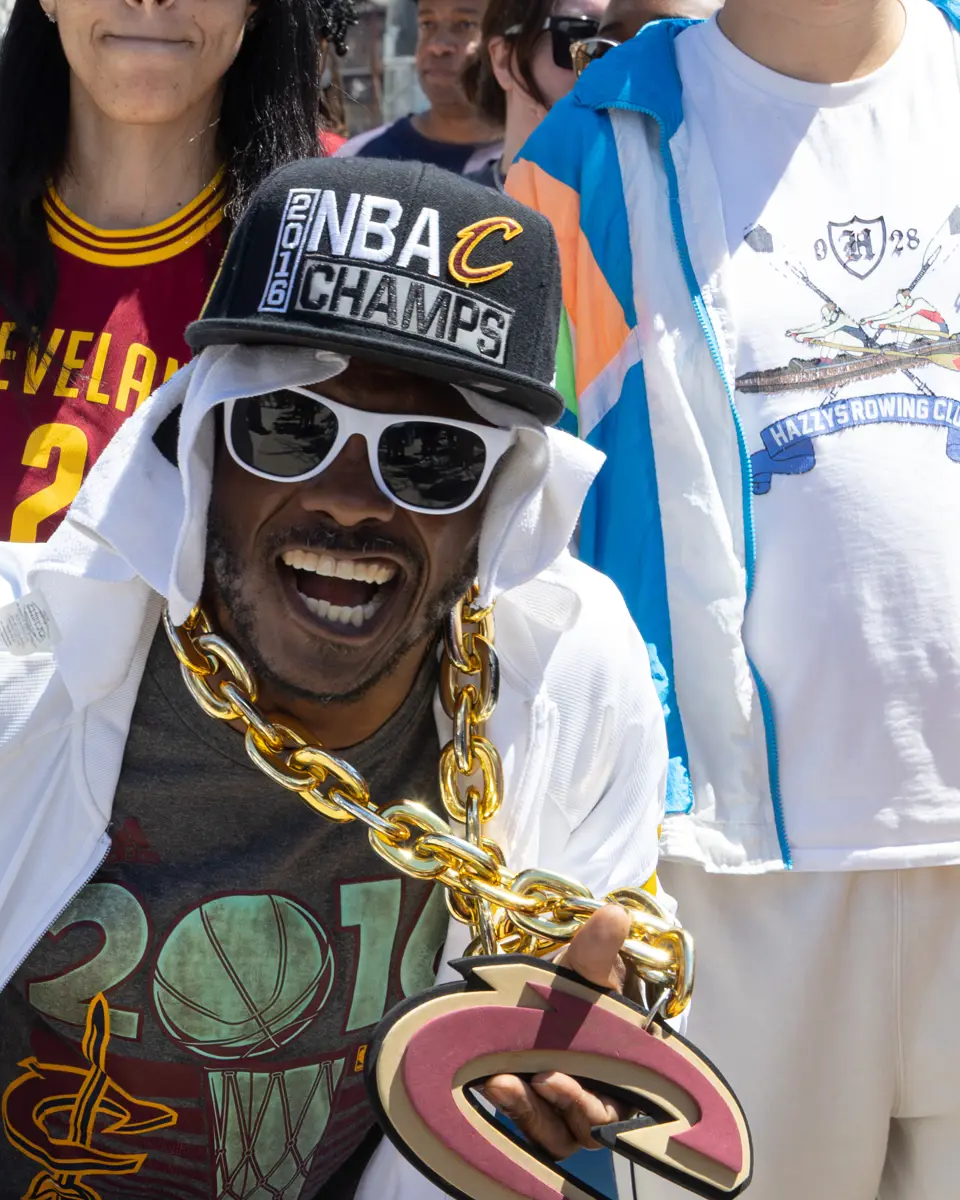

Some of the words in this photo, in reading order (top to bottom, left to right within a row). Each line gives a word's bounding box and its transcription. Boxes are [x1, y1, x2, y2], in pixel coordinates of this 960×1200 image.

[266, 194, 312, 306] 2016
[307, 189, 441, 278] NBA
[888, 227, 921, 257] 28
[299, 262, 506, 359] CHAMPS
[770, 404, 849, 446] HAZZYS
[850, 396, 929, 421] ROWING
